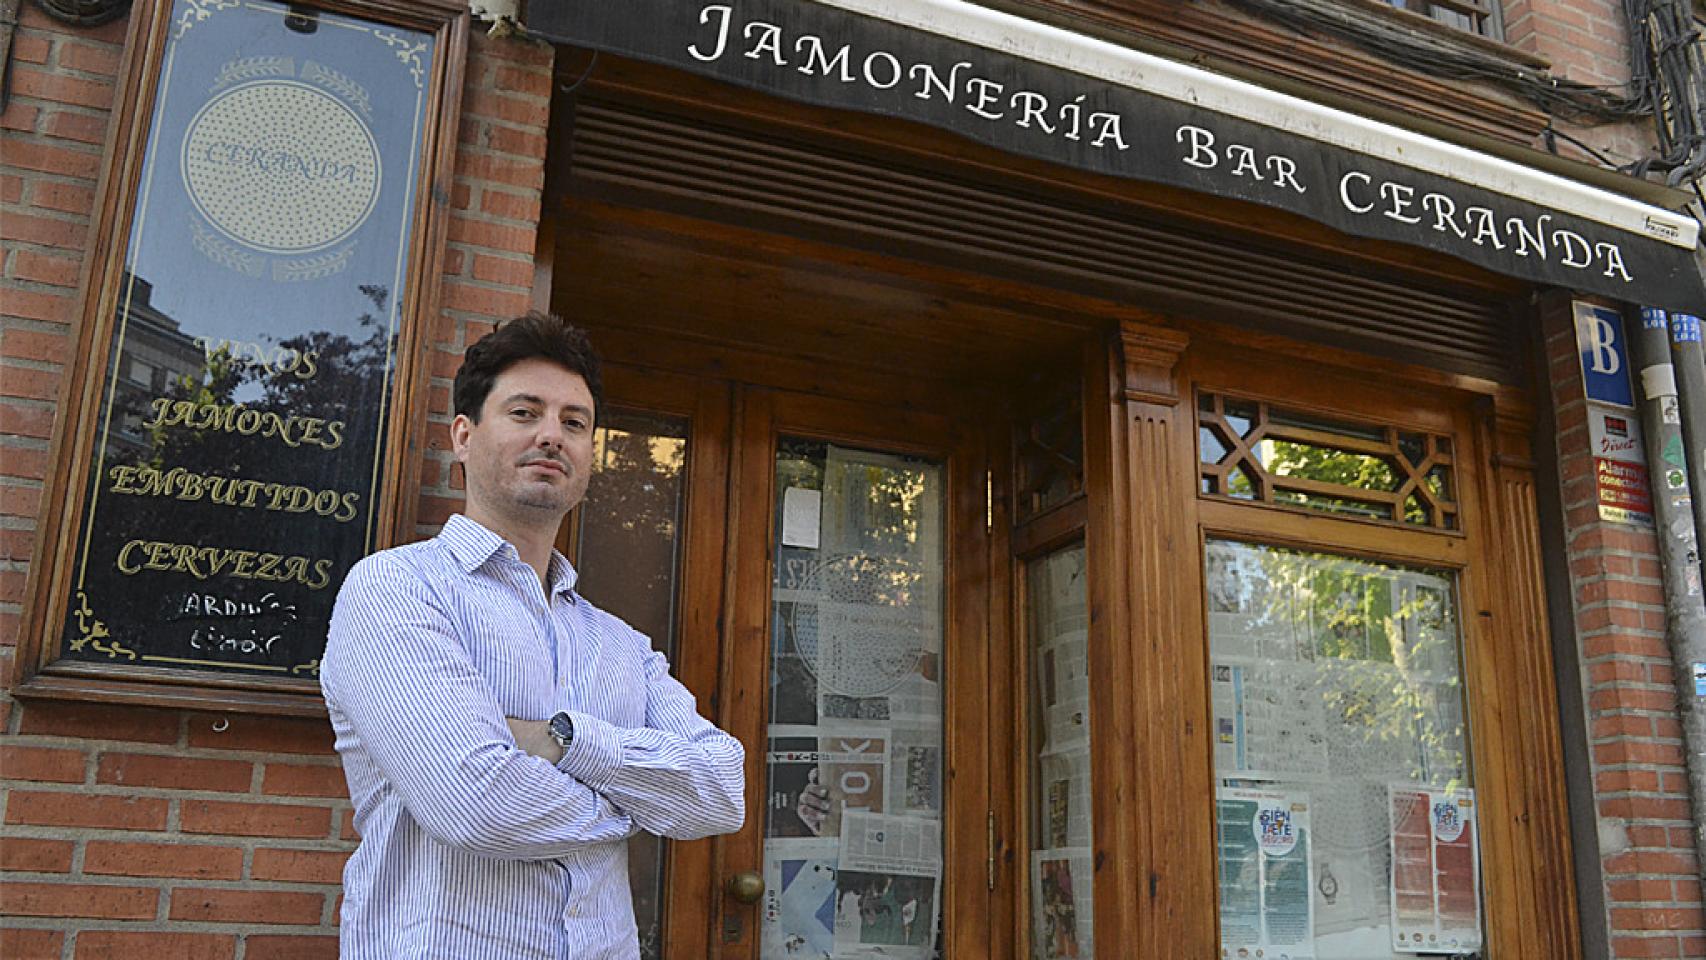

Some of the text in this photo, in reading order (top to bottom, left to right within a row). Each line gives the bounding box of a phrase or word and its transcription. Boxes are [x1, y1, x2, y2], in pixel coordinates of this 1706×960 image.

[208, 141, 355, 184] CERANDA
[687, 6, 1633, 282] JAMONERÍA BAR CERANDA
[193, 336, 321, 379] VINOS
[1585, 315, 1620, 375] B
[143, 397, 346, 450] JAMONES
[109, 464, 361, 523] EMBUTIDOS
[117, 540, 334, 590] CERVEZAS
